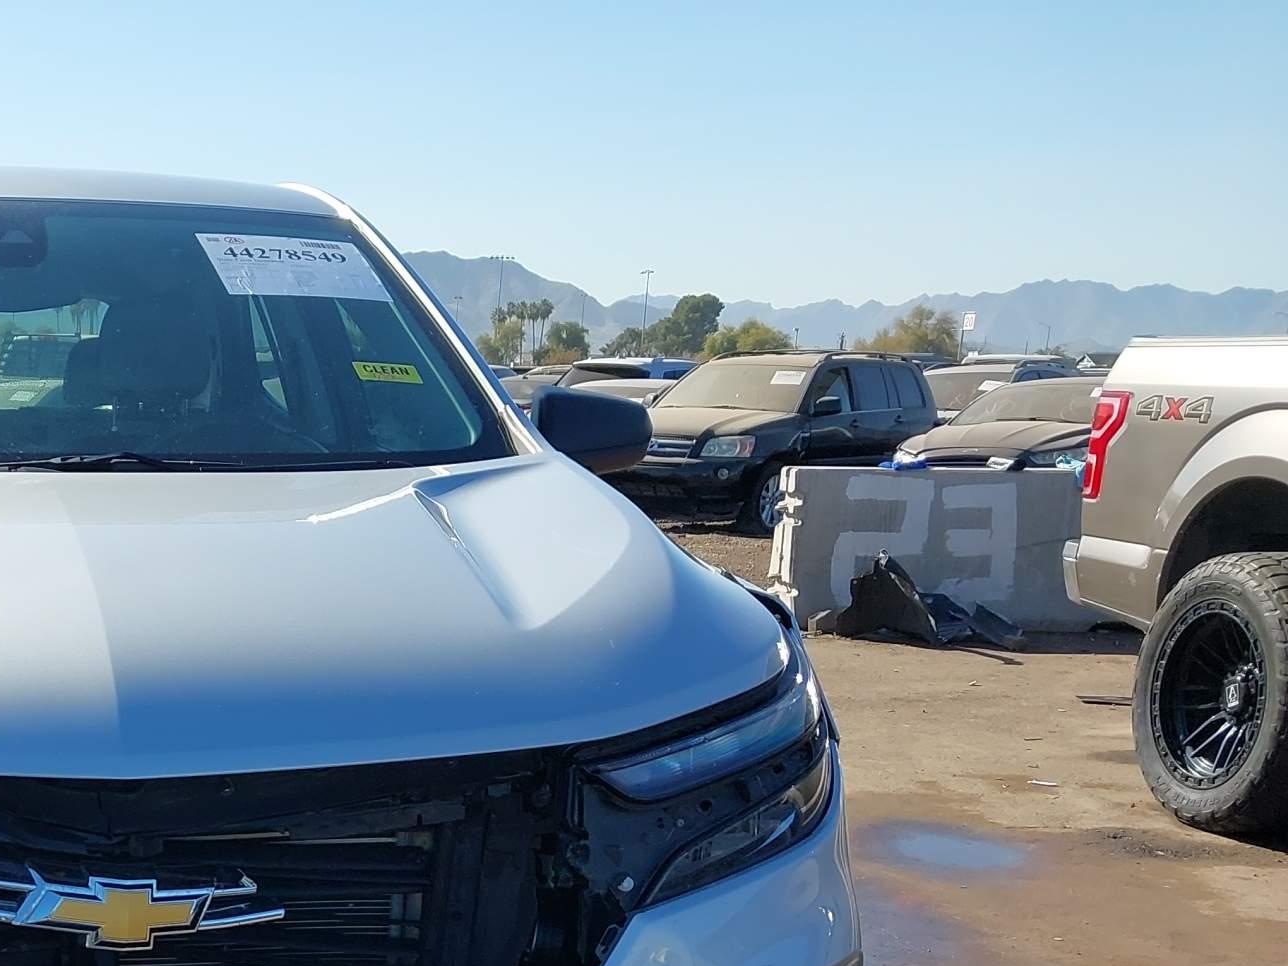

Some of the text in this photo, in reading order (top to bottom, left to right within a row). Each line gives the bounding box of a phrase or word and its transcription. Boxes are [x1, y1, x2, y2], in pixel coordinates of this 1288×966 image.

[223, 246, 347, 264] 44278549
[362, 364, 410, 376] CLEAN
[831, 474, 1019, 612] 23
